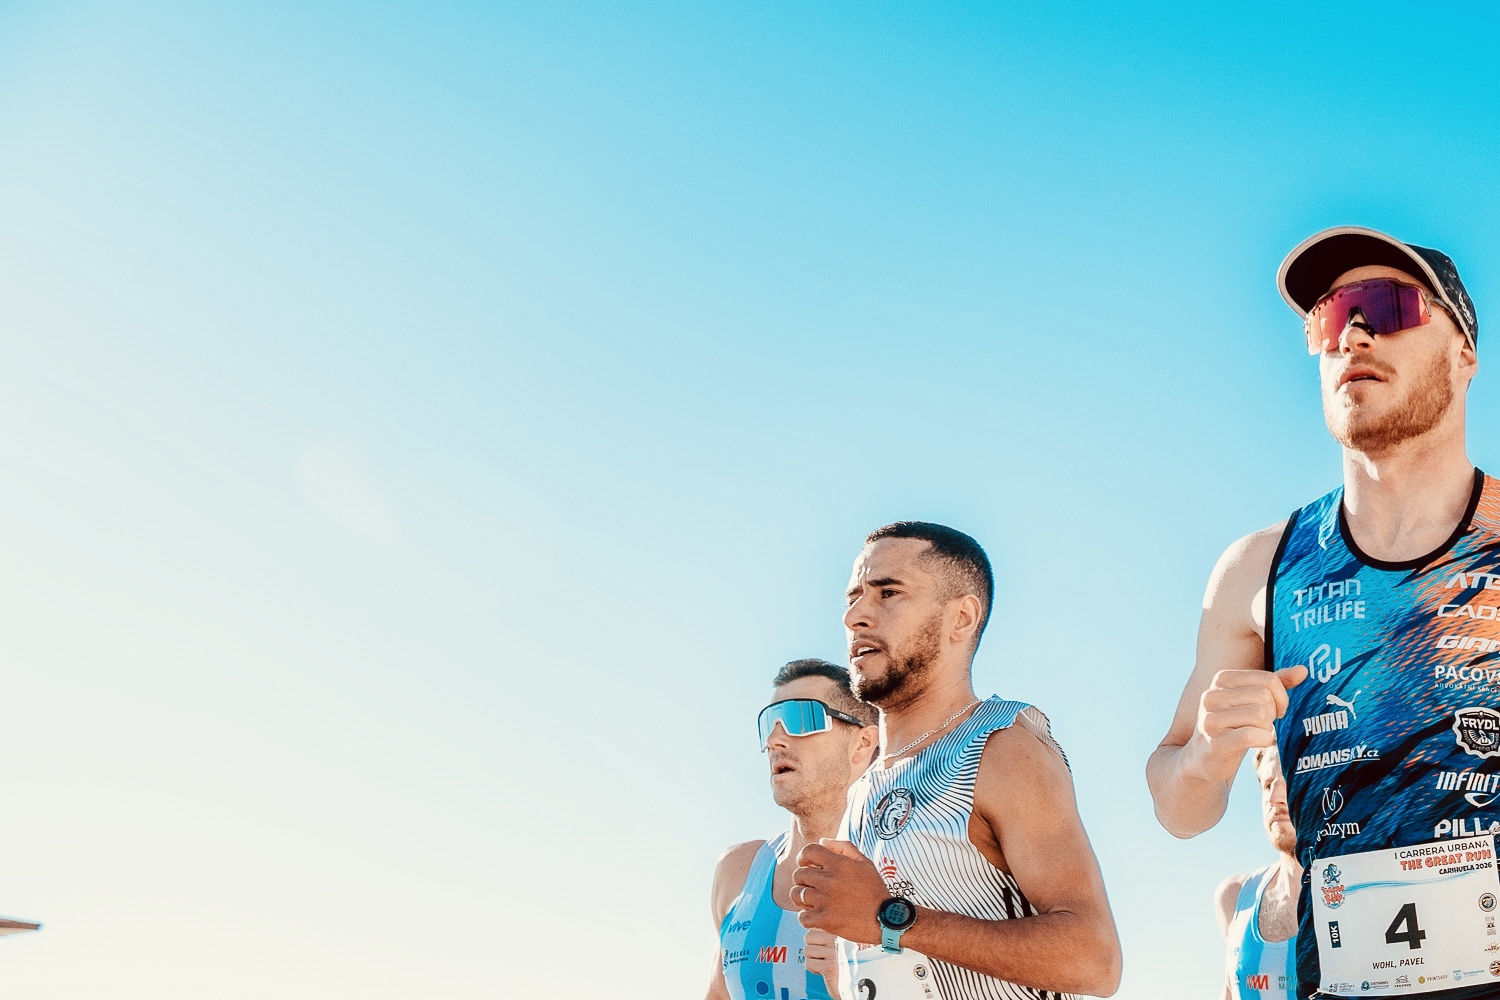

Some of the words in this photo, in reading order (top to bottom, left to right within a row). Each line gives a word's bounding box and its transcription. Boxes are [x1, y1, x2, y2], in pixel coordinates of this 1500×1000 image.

[1293, 579, 1361, 607] TITAN
[1290, 600, 1366, 633] TRILIFE
[1303, 710, 1348, 737] PUMA
[1461, 717, 1500, 731] FRYDL
[1394, 852, 1398, 860] I
[1400, 846, 1446, 859] CARRERA
[1447, 840, 1489, 853] URBANA
[1400, 858, 1422, 871] THE
[1425, 852, 1463, 868] GREAT
[1465, 848, 1492, 862] RUN
[1438, 865, 1475, 875] CARIHUELA
[1475, 861, 1493, 870] 2026
[728, 920, 752, 934] vive
[1330, 925, 1339, 944] 10K
[1384, 902, 1427, 951] 4
[1372, 960, 1397, 970] WOHL,
[1400, 957, 1424, 967] PAVEL
